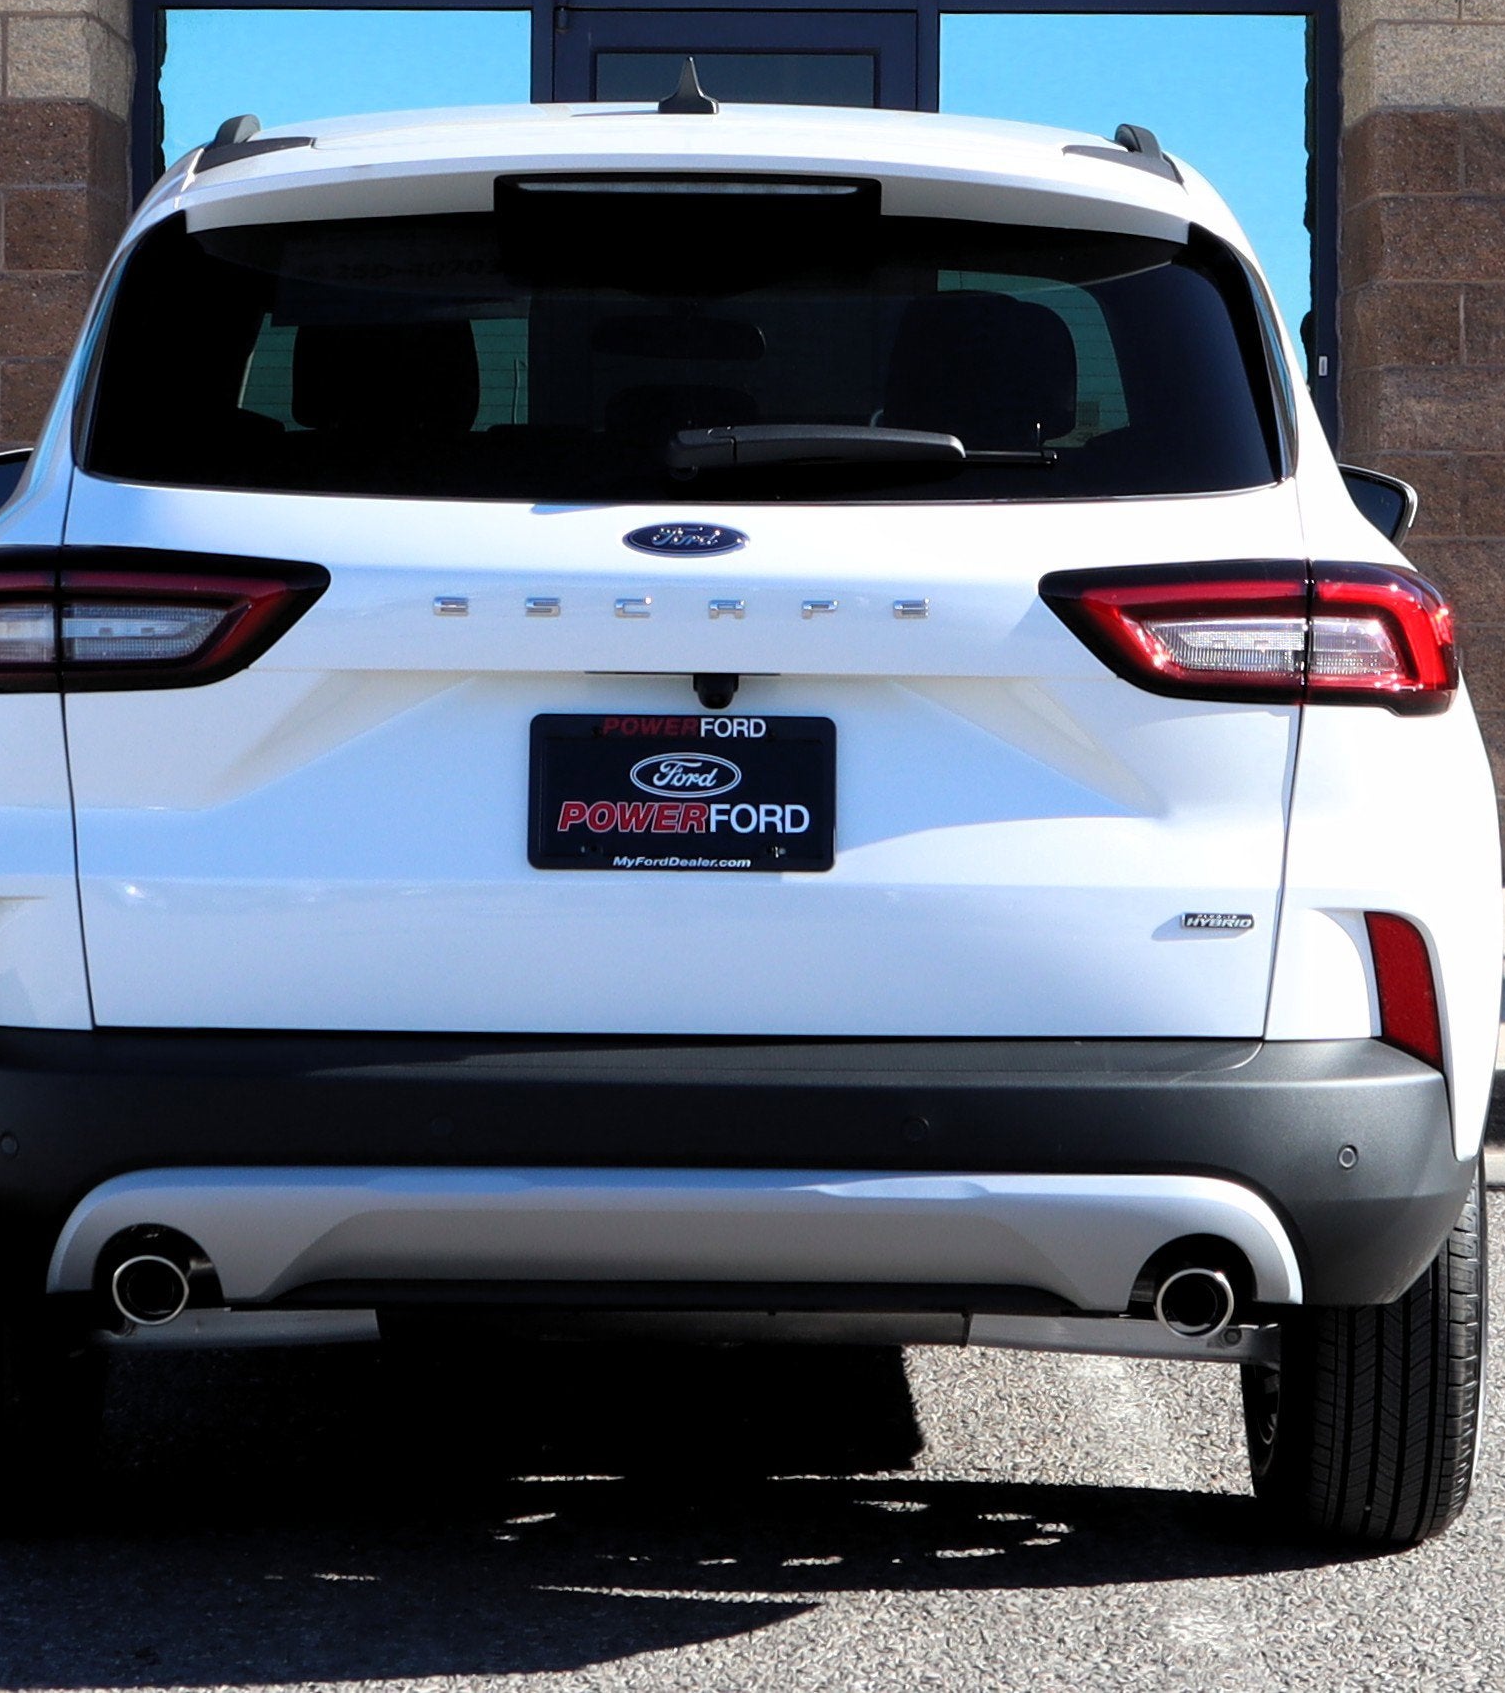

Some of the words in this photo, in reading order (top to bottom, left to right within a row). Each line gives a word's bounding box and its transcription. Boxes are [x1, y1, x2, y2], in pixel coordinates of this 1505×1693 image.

[651, 527, 719, 545] Ford
[432, 596, 930, 619] ESCAPE
[653, 761, 719, 788] Ford
[557, 801, 810, 834] POWERFORD
[613, 855, 752, 870] MyFordDealer.com
[1186, 917, 1252, 927] HYBRID
